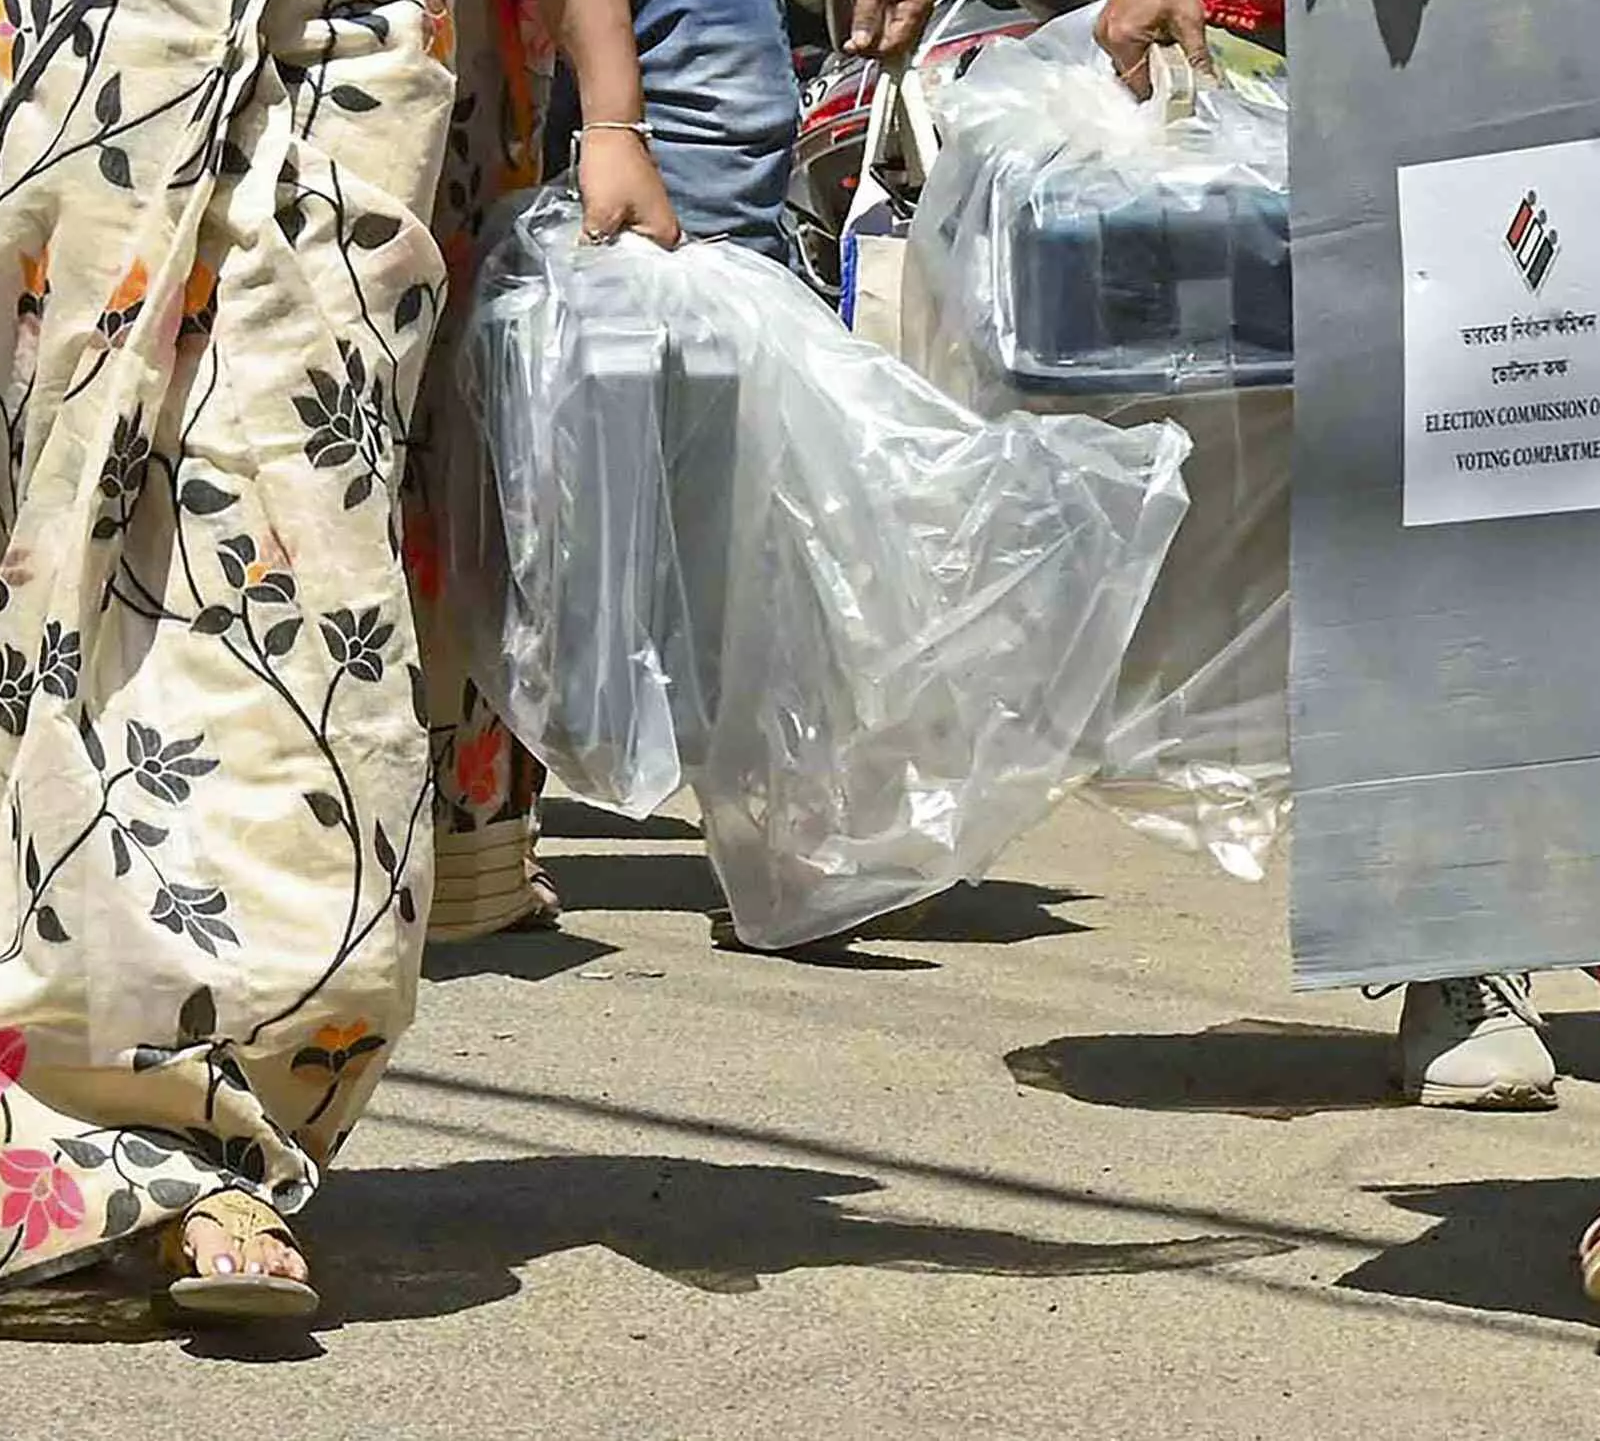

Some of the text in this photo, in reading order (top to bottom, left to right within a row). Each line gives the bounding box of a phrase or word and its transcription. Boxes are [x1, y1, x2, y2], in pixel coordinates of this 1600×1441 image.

[1425, 408, 1496, 433] ELECTION
[1498, 397, 1588, 427] COMMISSION
[1456, 448, 1511, 472] VOTING
